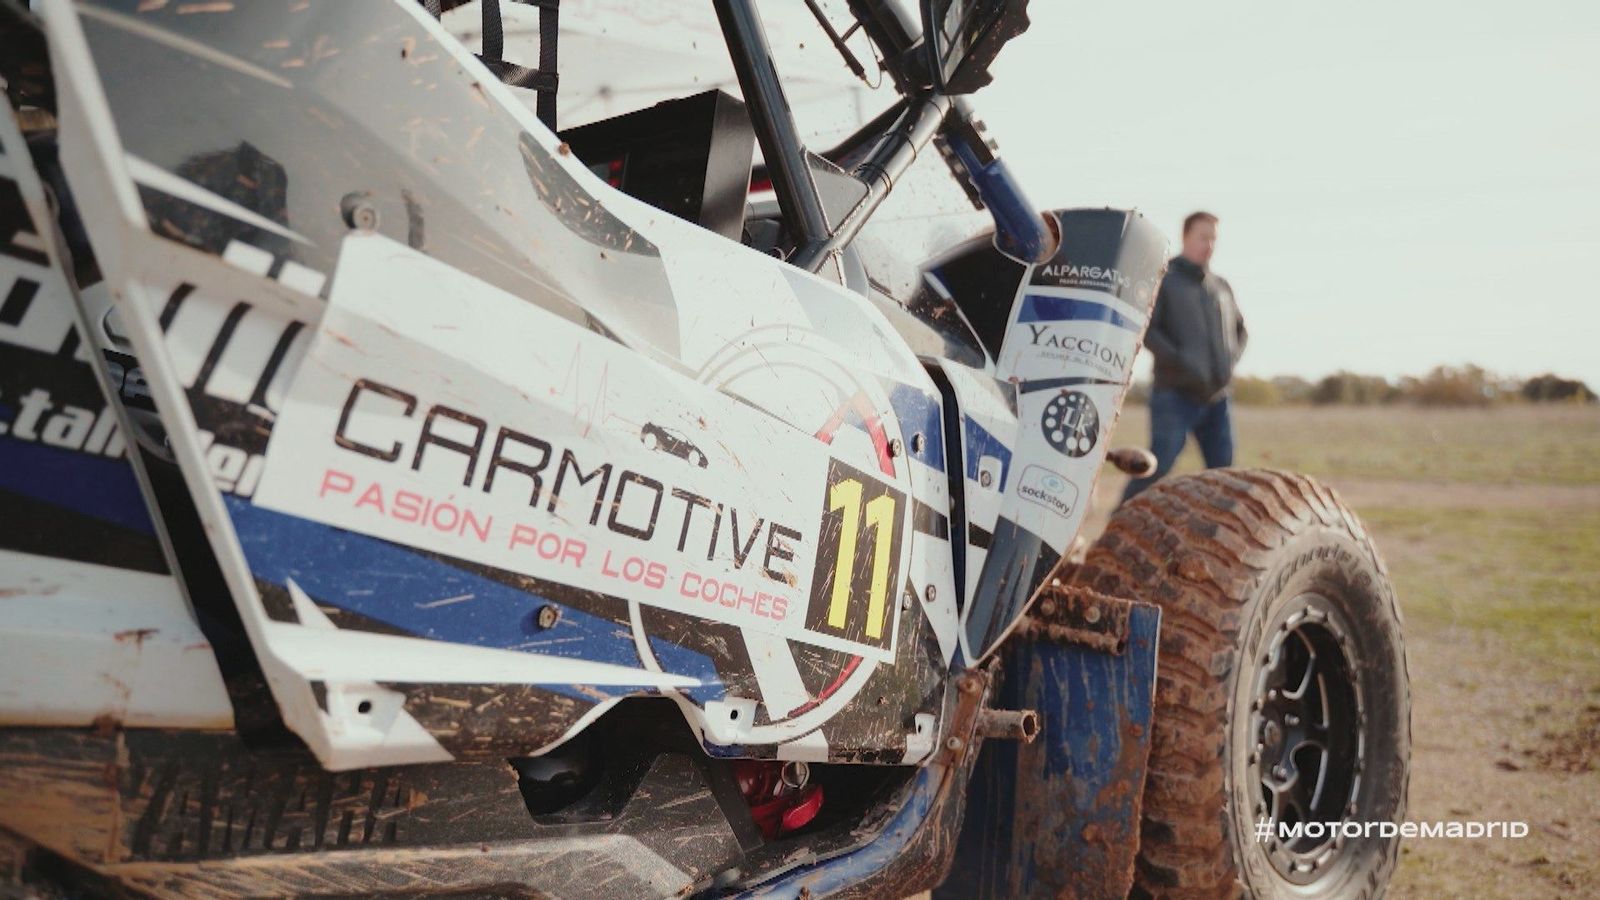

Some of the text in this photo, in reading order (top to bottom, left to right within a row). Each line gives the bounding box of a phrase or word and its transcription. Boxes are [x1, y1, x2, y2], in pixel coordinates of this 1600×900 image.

[1028, 323, 1127, 369] YACCION
[319, 469, 789, 621] PASIÓN POR LOS COCHES
[334, 377, 803, 586] CARMOTIVE
[1021, 485, 1070, 515] sockstory
[829, 477, 896, 640] 11
